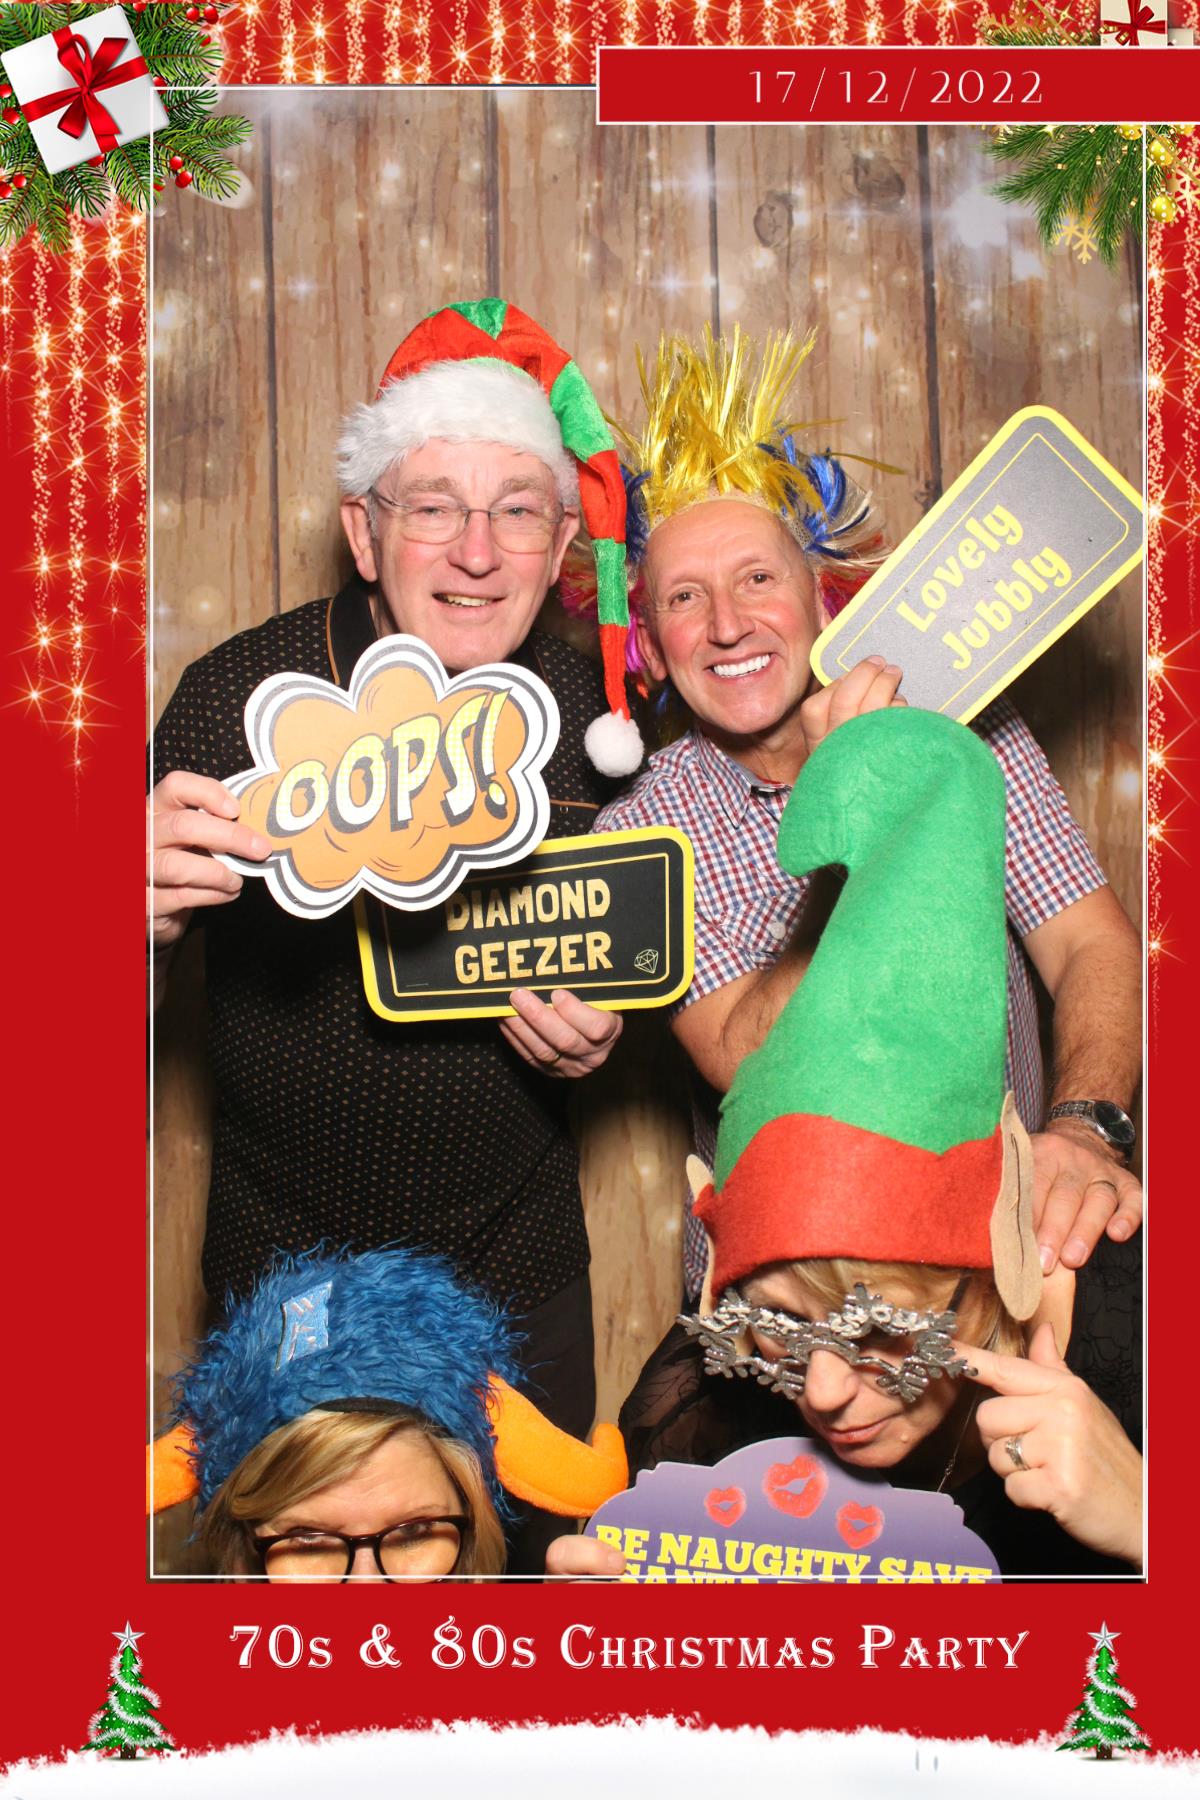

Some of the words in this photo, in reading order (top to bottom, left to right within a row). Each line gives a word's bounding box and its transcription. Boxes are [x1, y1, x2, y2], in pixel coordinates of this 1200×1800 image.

[896, 504, 1024, 633] Lovely
[942, 546, 1073, 670] Jubbly
[266, 687, 512, 840] OOPS!
[445, 878, 611, 932] DIAMOND
[454, 931, 614, 985] GEEZER
[595, 1525, 651, 1562] BE
[656, 1532, 872, 1584] NAUGHTY
